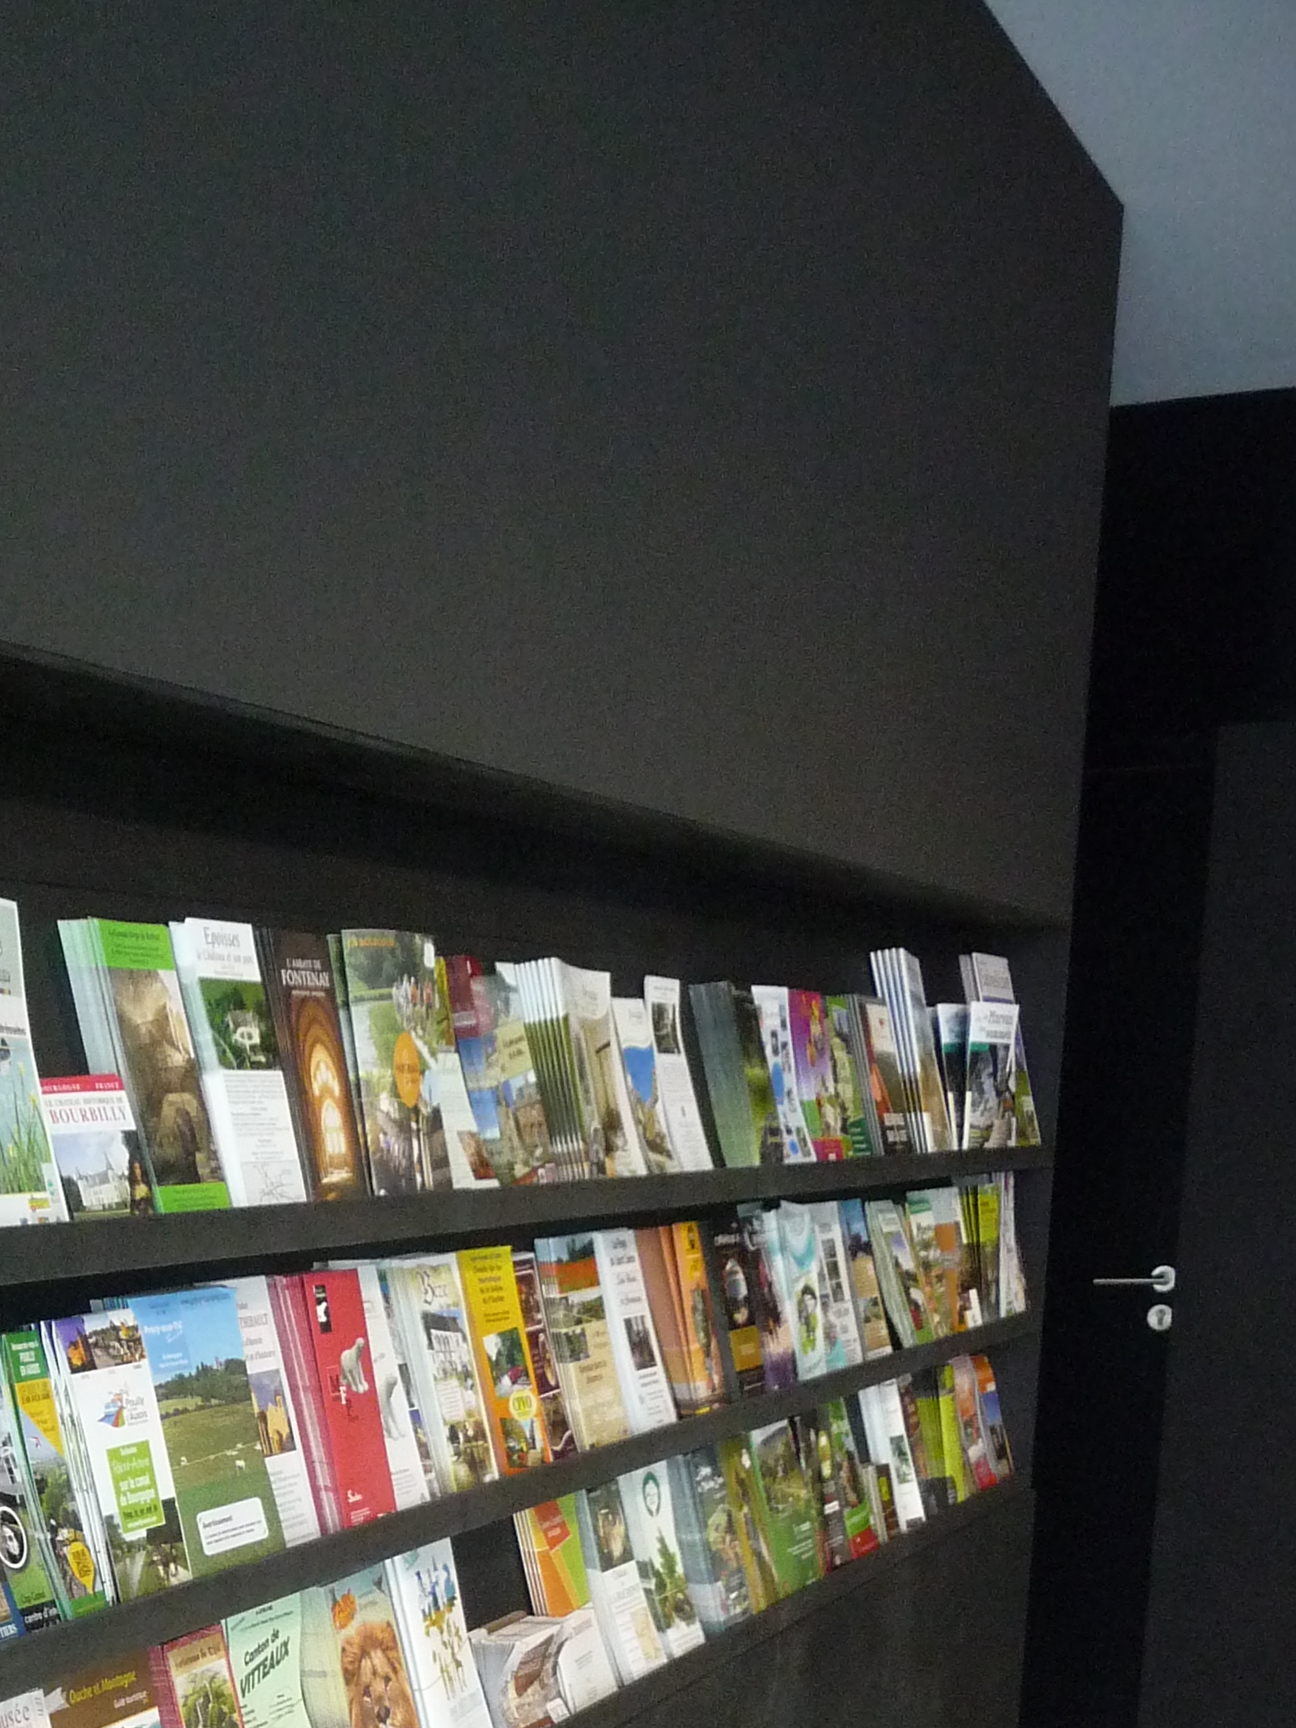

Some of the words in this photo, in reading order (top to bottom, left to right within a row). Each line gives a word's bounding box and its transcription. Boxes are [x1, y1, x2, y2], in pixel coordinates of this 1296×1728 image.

[281, 969, 330, 988] FONTENAY
[49, 1105, 127, 1125] BOURBILLY
[244, 1636, 271, 1666] Canton
[271, 1627, 281, 1643] de
[240, 1635, 290, 1700] VITTEAUX
